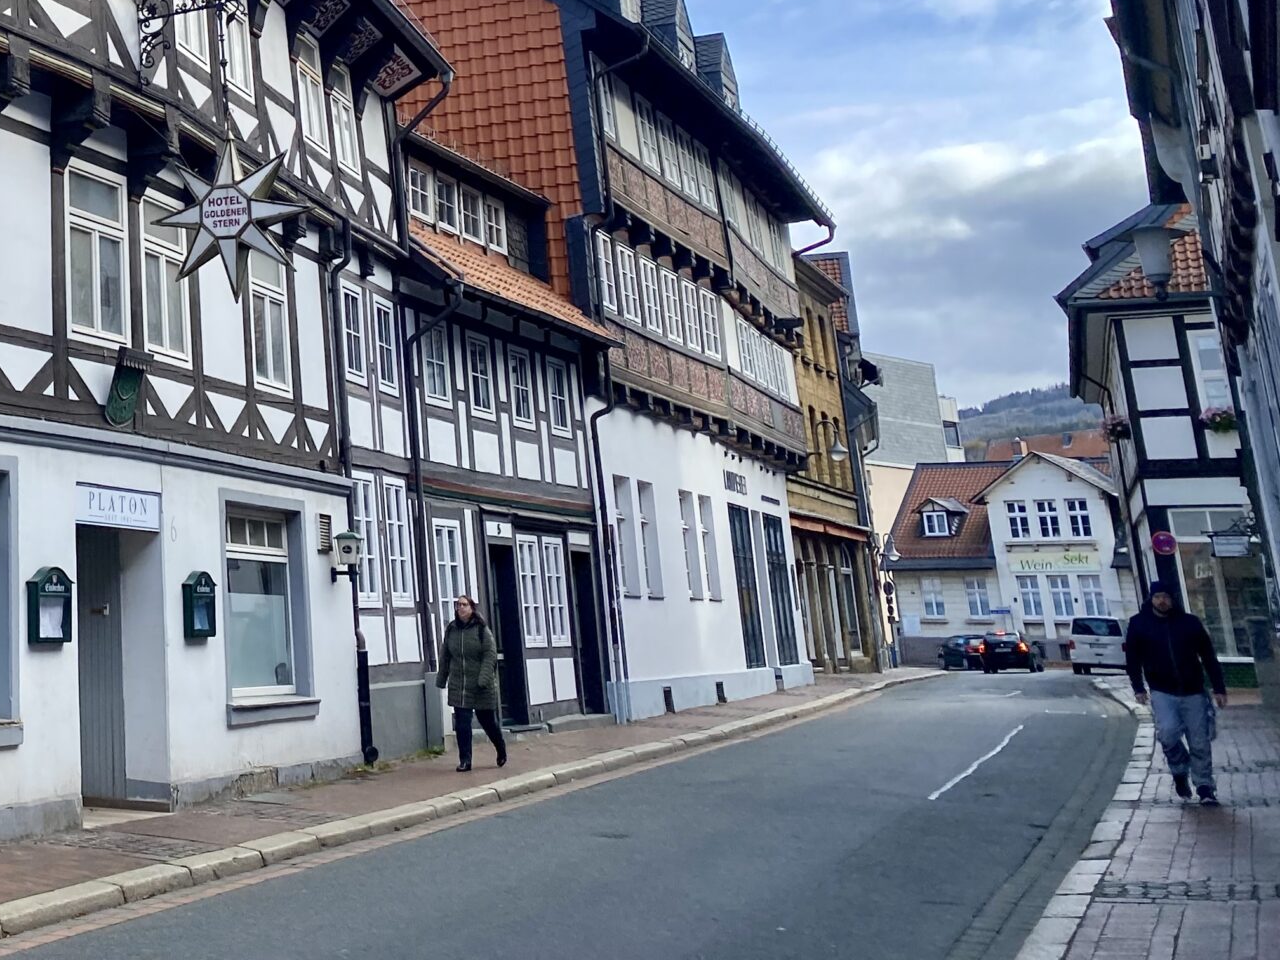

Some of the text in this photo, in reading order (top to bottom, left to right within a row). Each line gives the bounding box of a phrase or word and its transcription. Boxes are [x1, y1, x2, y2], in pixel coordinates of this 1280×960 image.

[208, 196, 242, 207] HOTEL
[204, 208, 247, 219] GOLDENER
[213, 219, 240, 228] STERN
[88, 490, 147, 516] PLATON
[1020, 559, 1053, 571] Wein
[1063, 553, 1089, 565] Sekt
